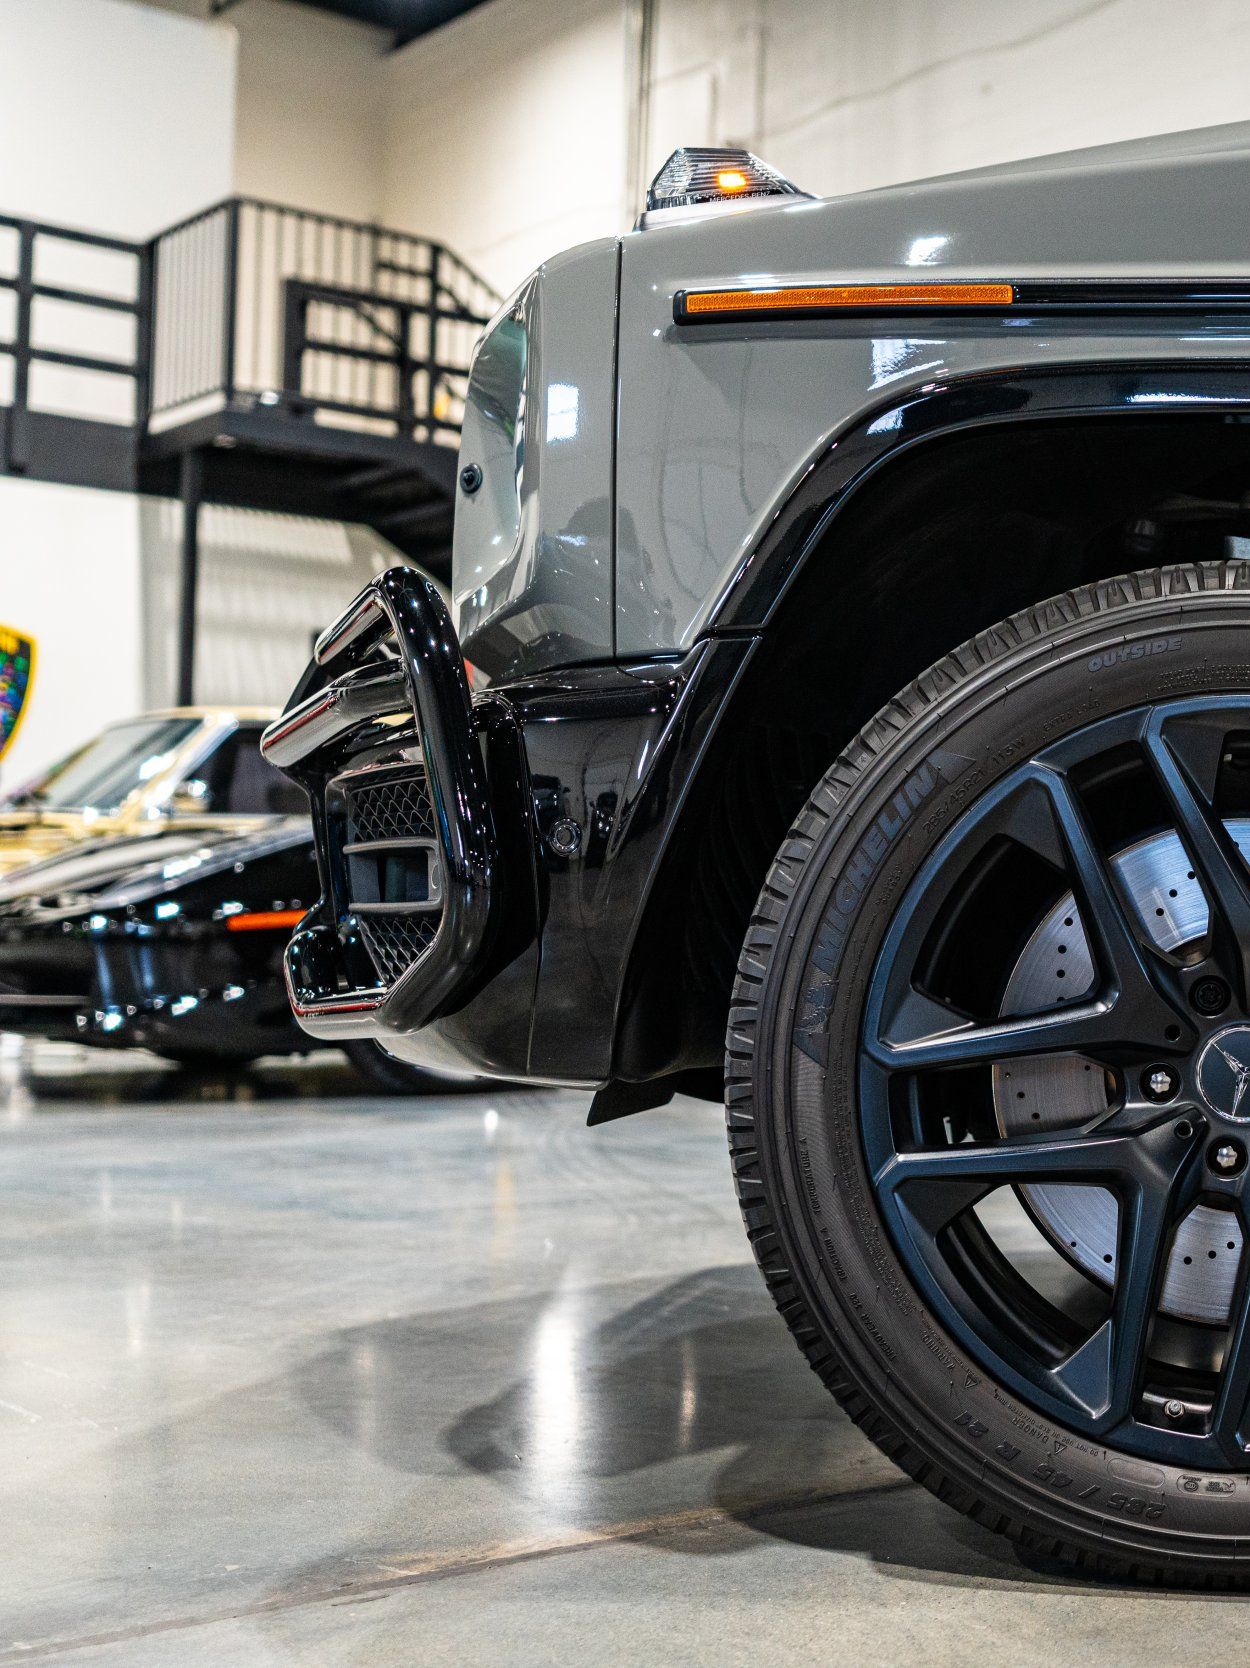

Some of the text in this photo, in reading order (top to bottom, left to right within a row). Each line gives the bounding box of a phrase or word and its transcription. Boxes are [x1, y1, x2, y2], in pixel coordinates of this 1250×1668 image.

[1085, 635, 1184, 674] OUTSIDE
[920, 733, 1029, 835] 285/45R21 113W
[806, 759, 944, 977] MICHELIN
[1009, 1415, 1050, 1445] DANGER
[1106, 1492, 1166, 1520] 285
